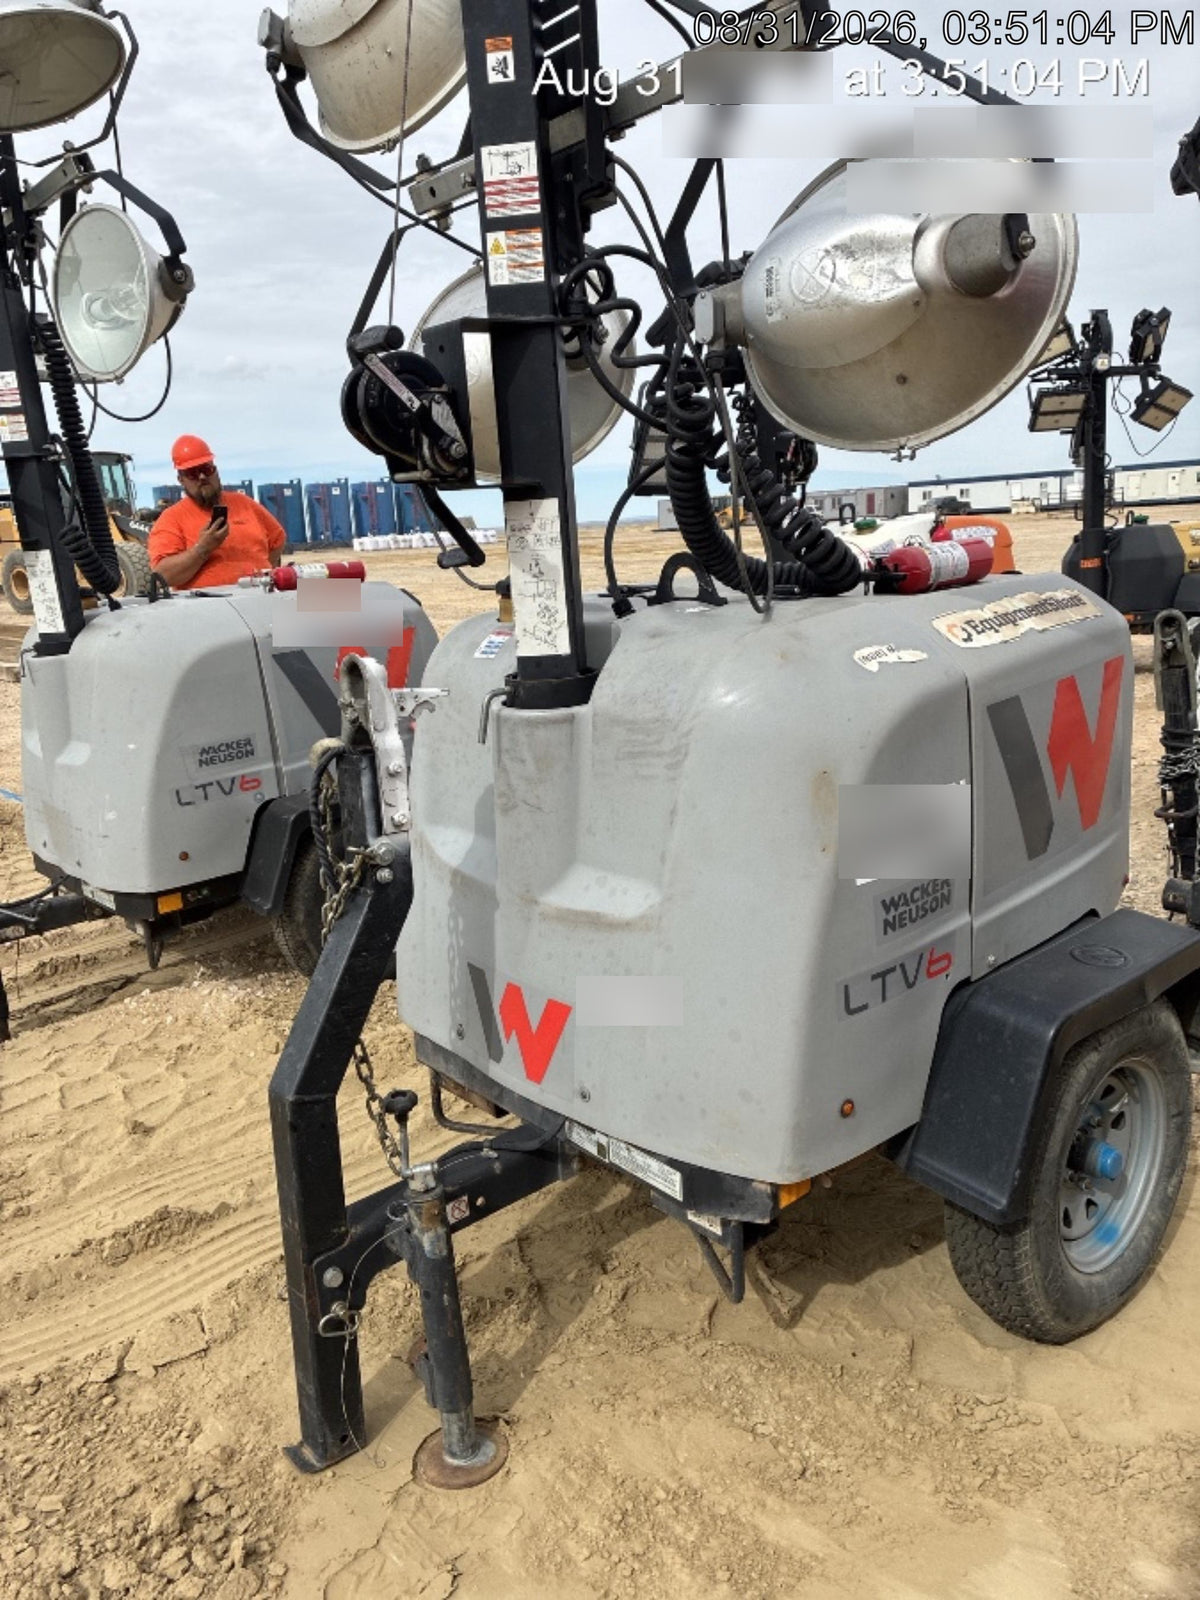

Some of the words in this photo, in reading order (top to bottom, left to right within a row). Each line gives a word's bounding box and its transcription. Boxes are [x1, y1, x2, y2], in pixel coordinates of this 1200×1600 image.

[967, 594, 1088, 635] EquipmentShare
[198, 748, 255, 768] NEUSON
[199, 738, 254, 757] WACKER
[175, 774, 261, 807] LTV6
[882, 889, 952, 936] NEUSON
[843, 947, 952, 1016] LTV6
